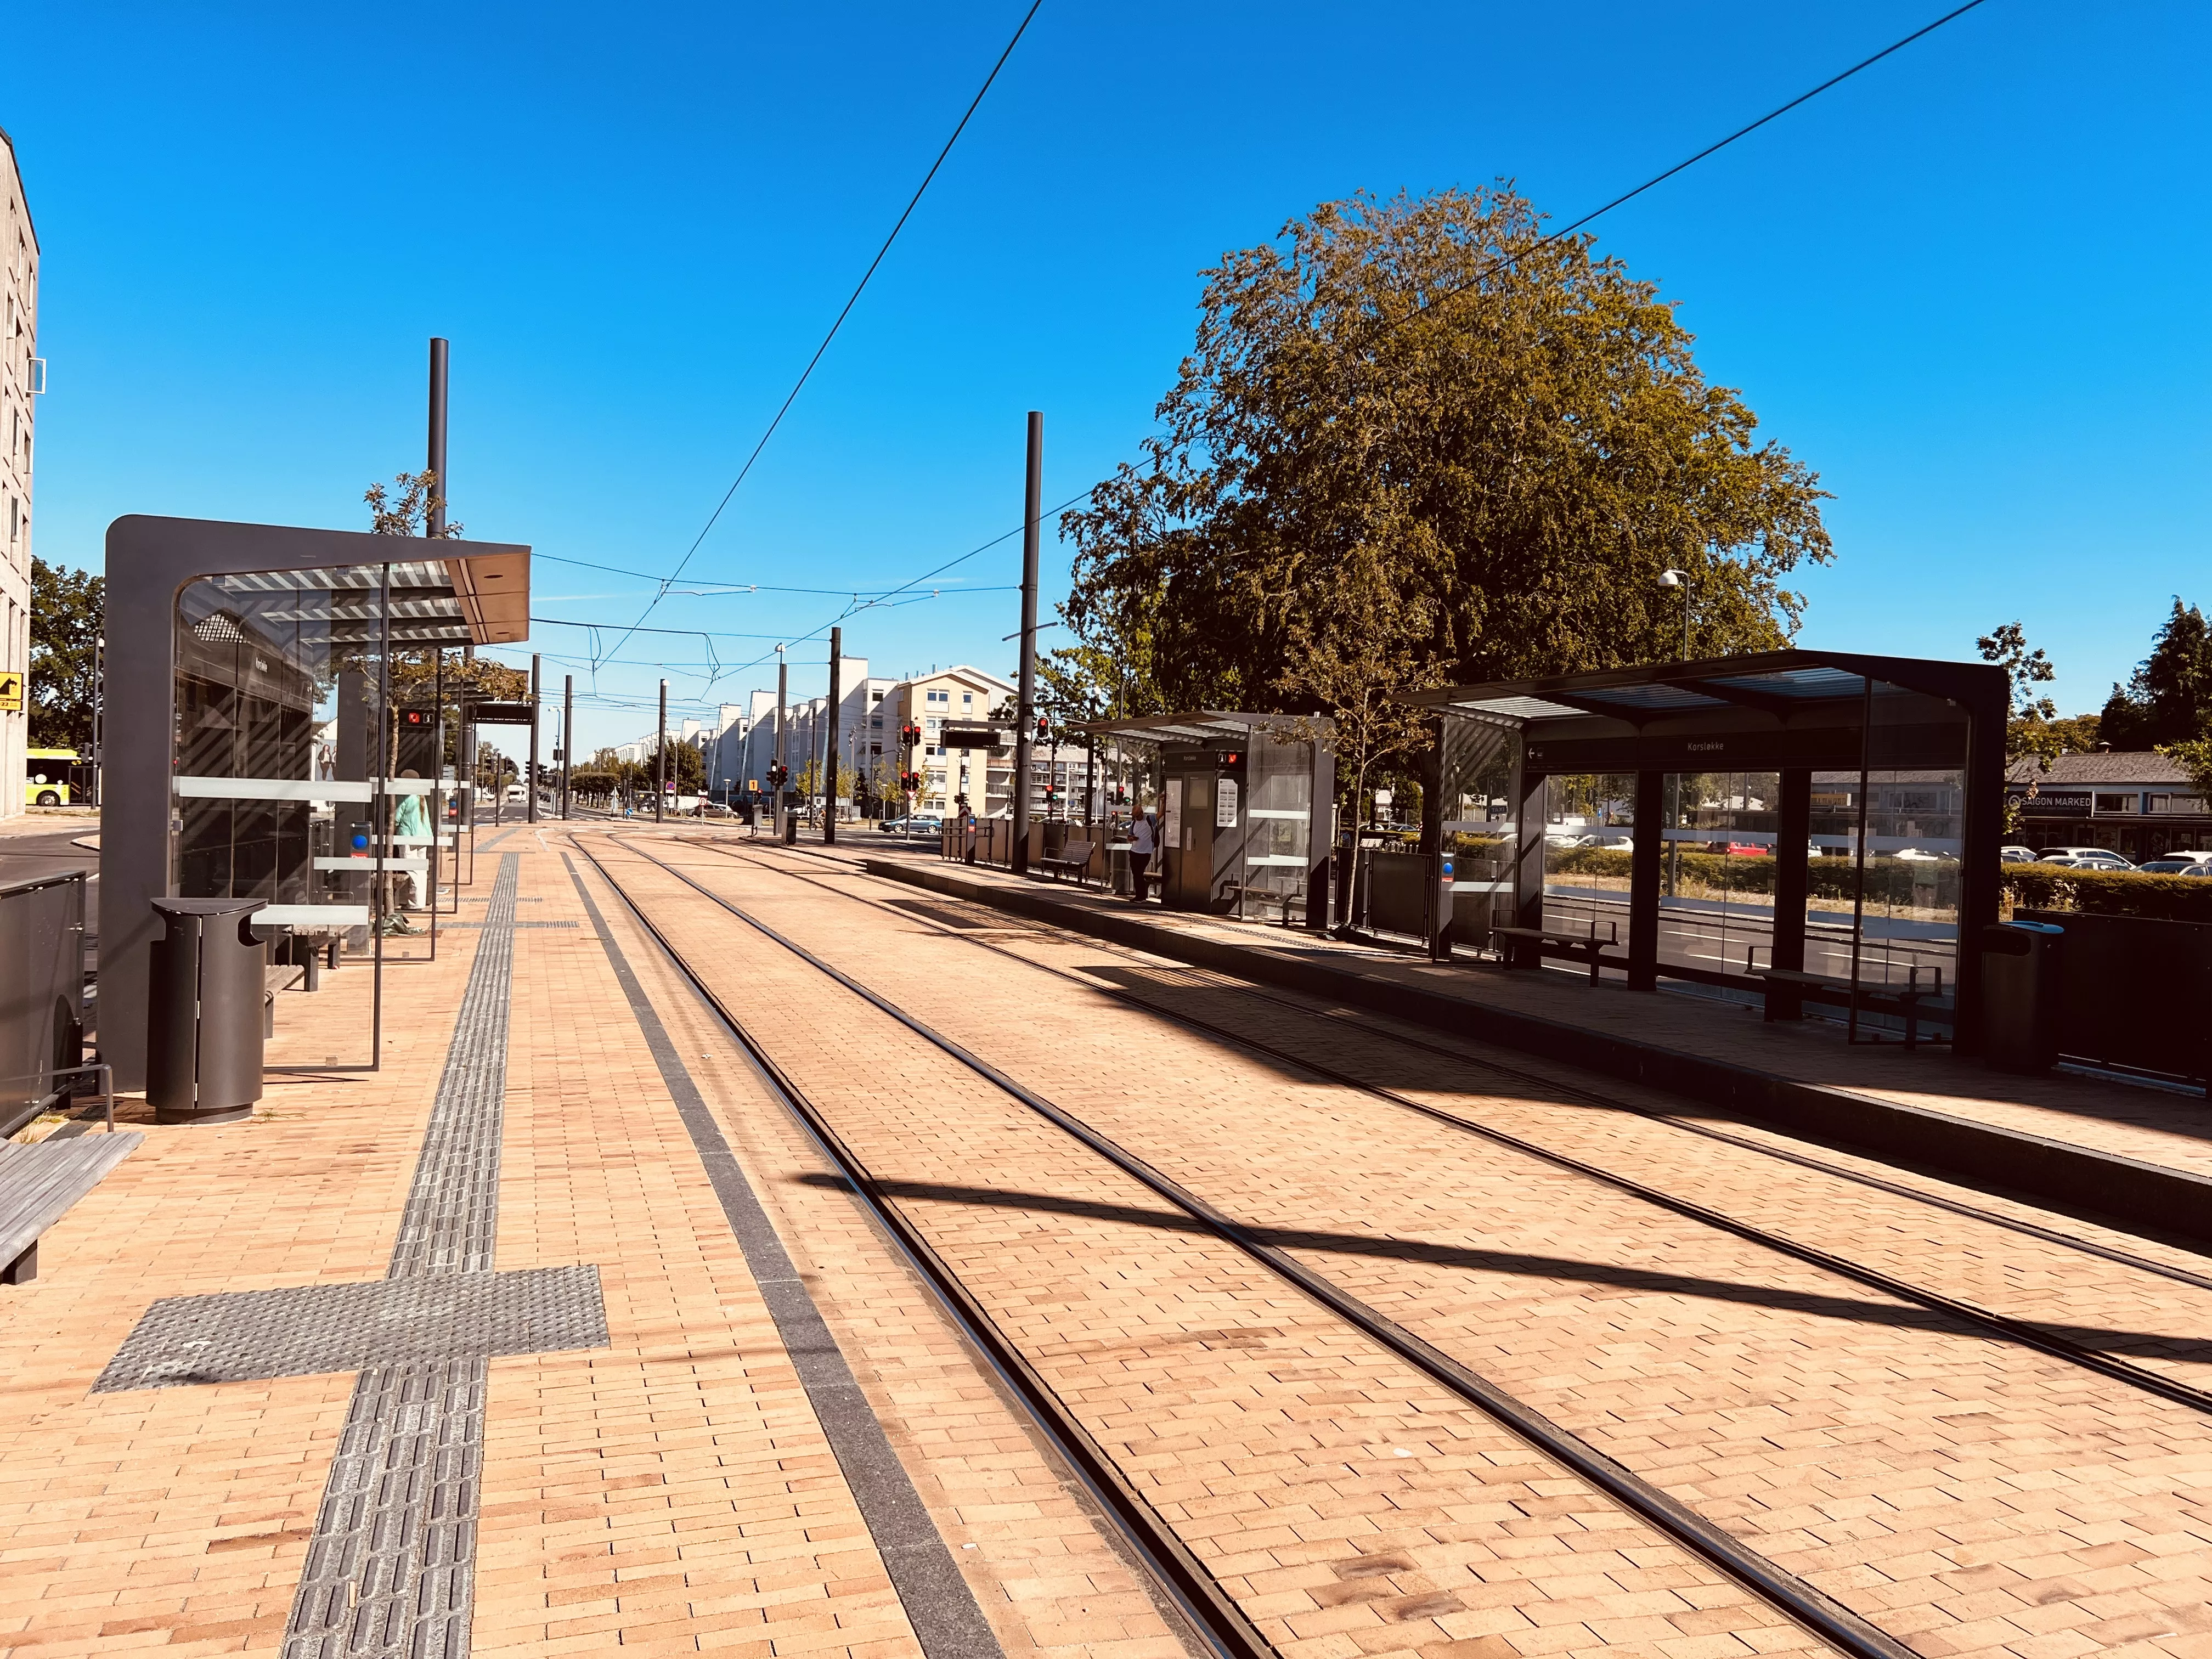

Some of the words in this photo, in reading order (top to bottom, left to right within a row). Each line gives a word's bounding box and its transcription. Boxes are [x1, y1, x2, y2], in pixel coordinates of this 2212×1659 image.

[1688, 741, 1724, 751] Korsløkke
[752, 781, 755, 789] 1
[2022, 797, 2053, 806] SAIGON
[2055, 797, 2091, 806] MARKED
